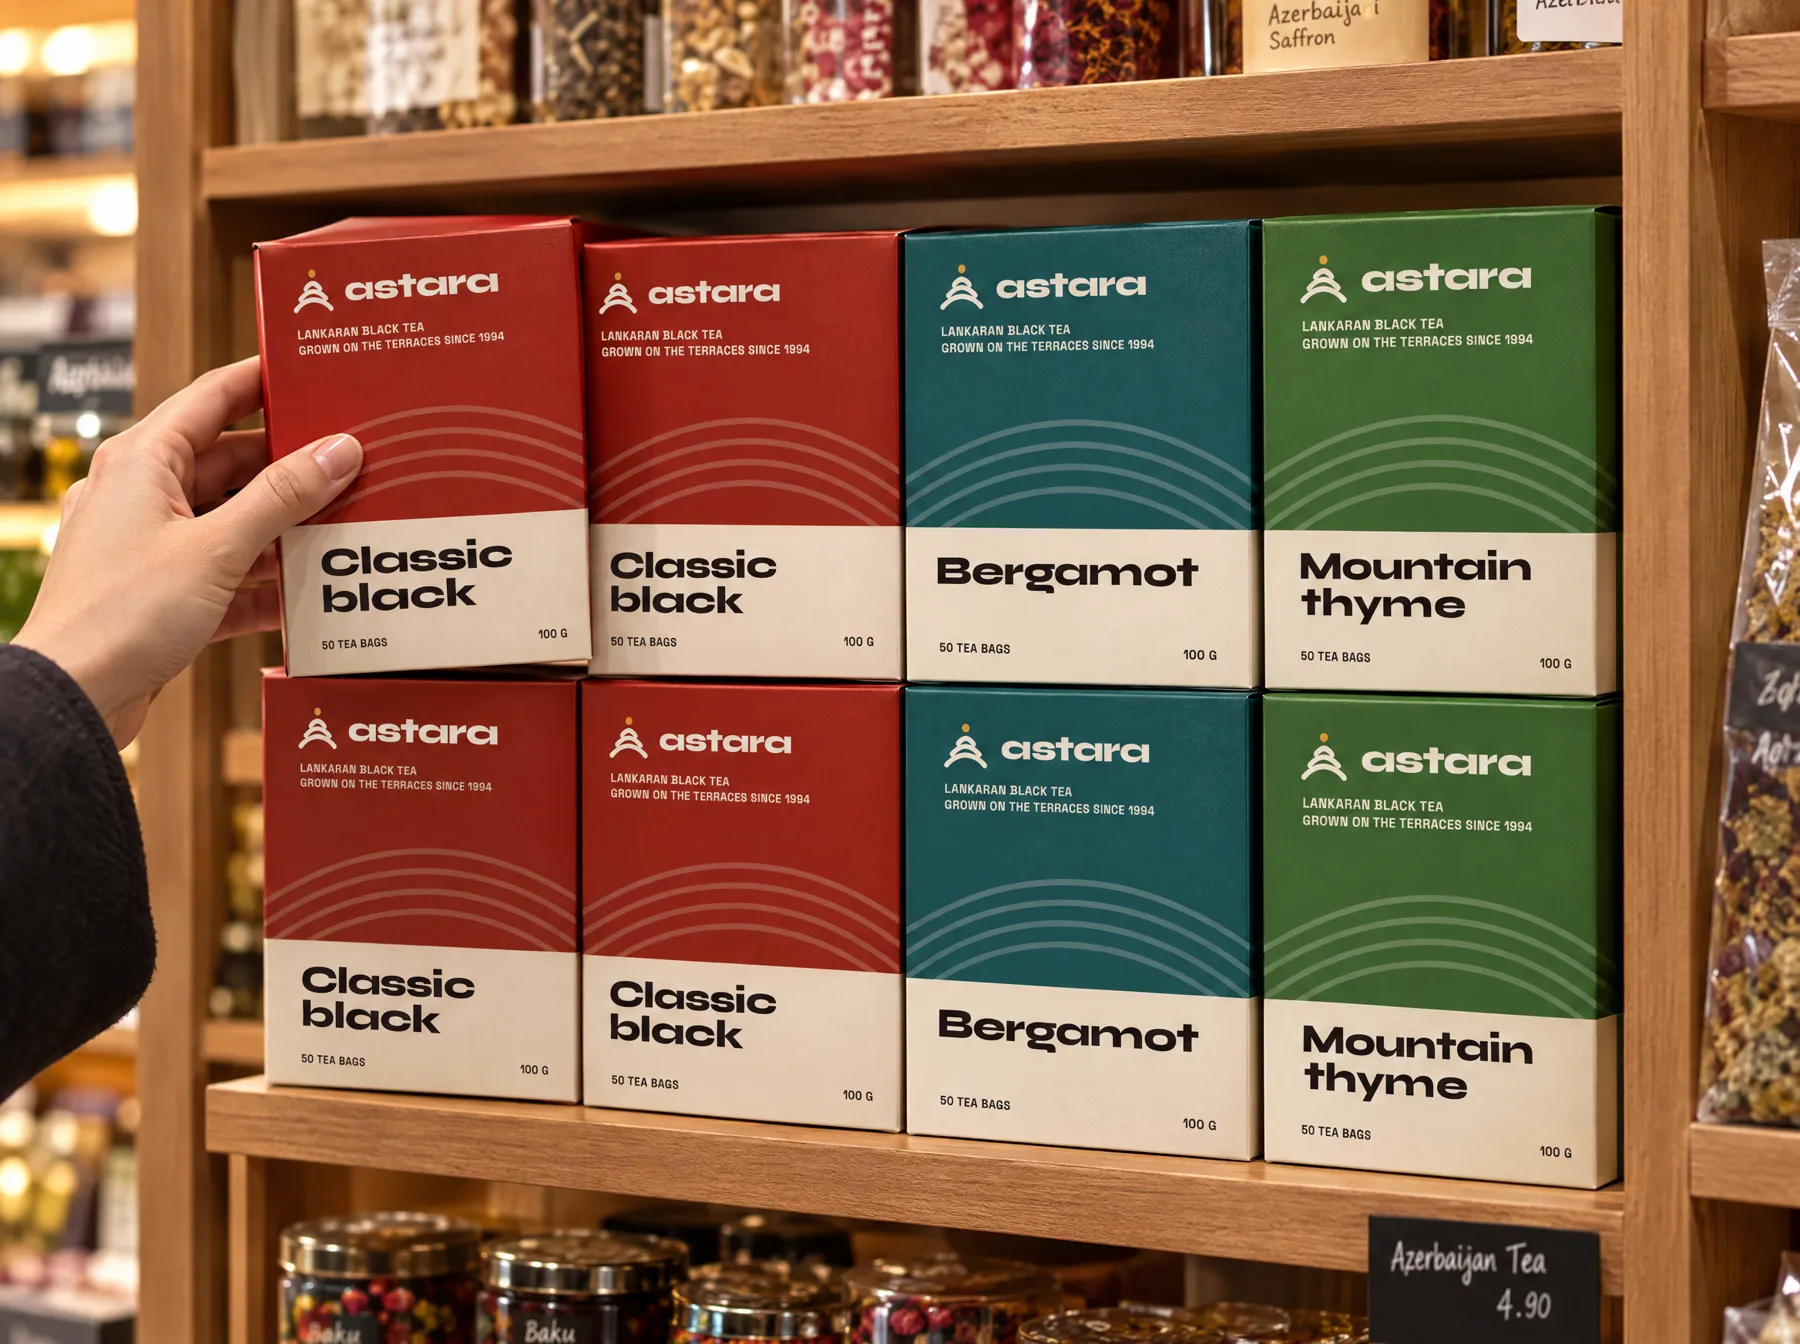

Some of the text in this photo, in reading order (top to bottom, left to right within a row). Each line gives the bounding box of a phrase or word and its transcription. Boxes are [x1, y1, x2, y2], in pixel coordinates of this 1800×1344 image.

[1269, 27, 1336, 50] Saffron
[345, 273, 498, 300] astara
[997, 273, 1146, 298] astara
[1362, 264, 1531, 292] astara
[649, 281, 780, 304] astara
[297, 321, 425, 340] LANKARAN BLACK TEA
[941, 324, 1070, 337] LANKARAN BLACK TEA
[1302, 317, 1444, 332] LANKARAN BLACK TEA
[298, 330, 506, 356] GROWN ON THE TERRACES SINCE 1994
[601, 329, 723, 341] LANKARAN BLACK TEA
[1302, 333, 1534, 350] GROWN ON THE TERRACES SINCE 1994
[601, 343, 811, 358] GROWN ON THE TERRACES SINCE 1994
[941, 338, 1155, 354] GROWN ON THE TERRACES SINCE 1994
[321, 539, 512, 576] Classic
[610, 549, 776, 579] Classic
[1301, 550, 1531, 580] Mountain
[938, 557, 1198, 593] Bergamot
[323, 578, 476, 613] black
[611, 586, 743, 613] black
[1301, 588, 1465, 625] thyme
[538, 627, 568, 639] 100 G
[610, 636, 677, 648] 50 TEA BAGS
[843, 636, 874, 647] 100 G
[321, 637, 388, 651] 50 TEA BAGS
[939, 642, 1011, 655] 50 TEA BAGS
[1183, 649, 1217, 661] 100 G
[1300, 650, 1371, 663] 50 TEA BAGS
[1539, 657, 1572, 670] 100 G
[349, 719, 498, 745] astara
[660, 730, 791, 753] astara
[1002, 737, 1149, 762] astara
[300, 762, 417, 776] LANKARAN BLACK TEA
[1362, 747, 1531, 776] astara
[300, 777, 493, 792] GROWN ON THE TERRACES SINCE 1994
[610, 772, 730, 787] LANKARAN BLACK TEA
[610, 788, 811, 805] GROWN ON THE TERRACES SINCE 1994
[944, 783, 1073, 797] LANKARAN BLACK TEA
[944, 799, 1155, 817] GROWN ON THE TERRACES SINCE 1994
[1302, 797, 1444, 813] LANKARAN BLACK TEA
[1302, 814, 1533, 832] GROWN ON THE TERRACES SINCE 1994
[302, 967, 474, 999] Classic
[610, 981, 776, 1015] Classic
[303, 1000, 441, 1034] black
[610, 1013, 743, 1049] black
[939, 1009, 1198, 1053] Bergamot
[1303, 1025, 1533, 1065] Mountain
[301, 1053, 366, 1068] 50 TEA BAGS
[519, 1064, 549, 1076] 100 G
[611, 1074, 679, 1090] 50 TEA BAGS
[1305, 1062, 1467, 1102] thyme
[842, 1089, 874, 1102] 100 G
[940, 1095, 1011, 1111] 50 TEA BAGS
[1182, 1117, 1217, 1131] 100 G
[1301, 1124, 1372, 1141] 50 TEA BAGS
[1539, 1145, 1572, 1159] 100 G
[1390, 1240, 1548, 1286] Azerbaijan Tea
[1496, 1287, 1552, 1321] 4.90
[524, 1318, 577, 1344] Baku
